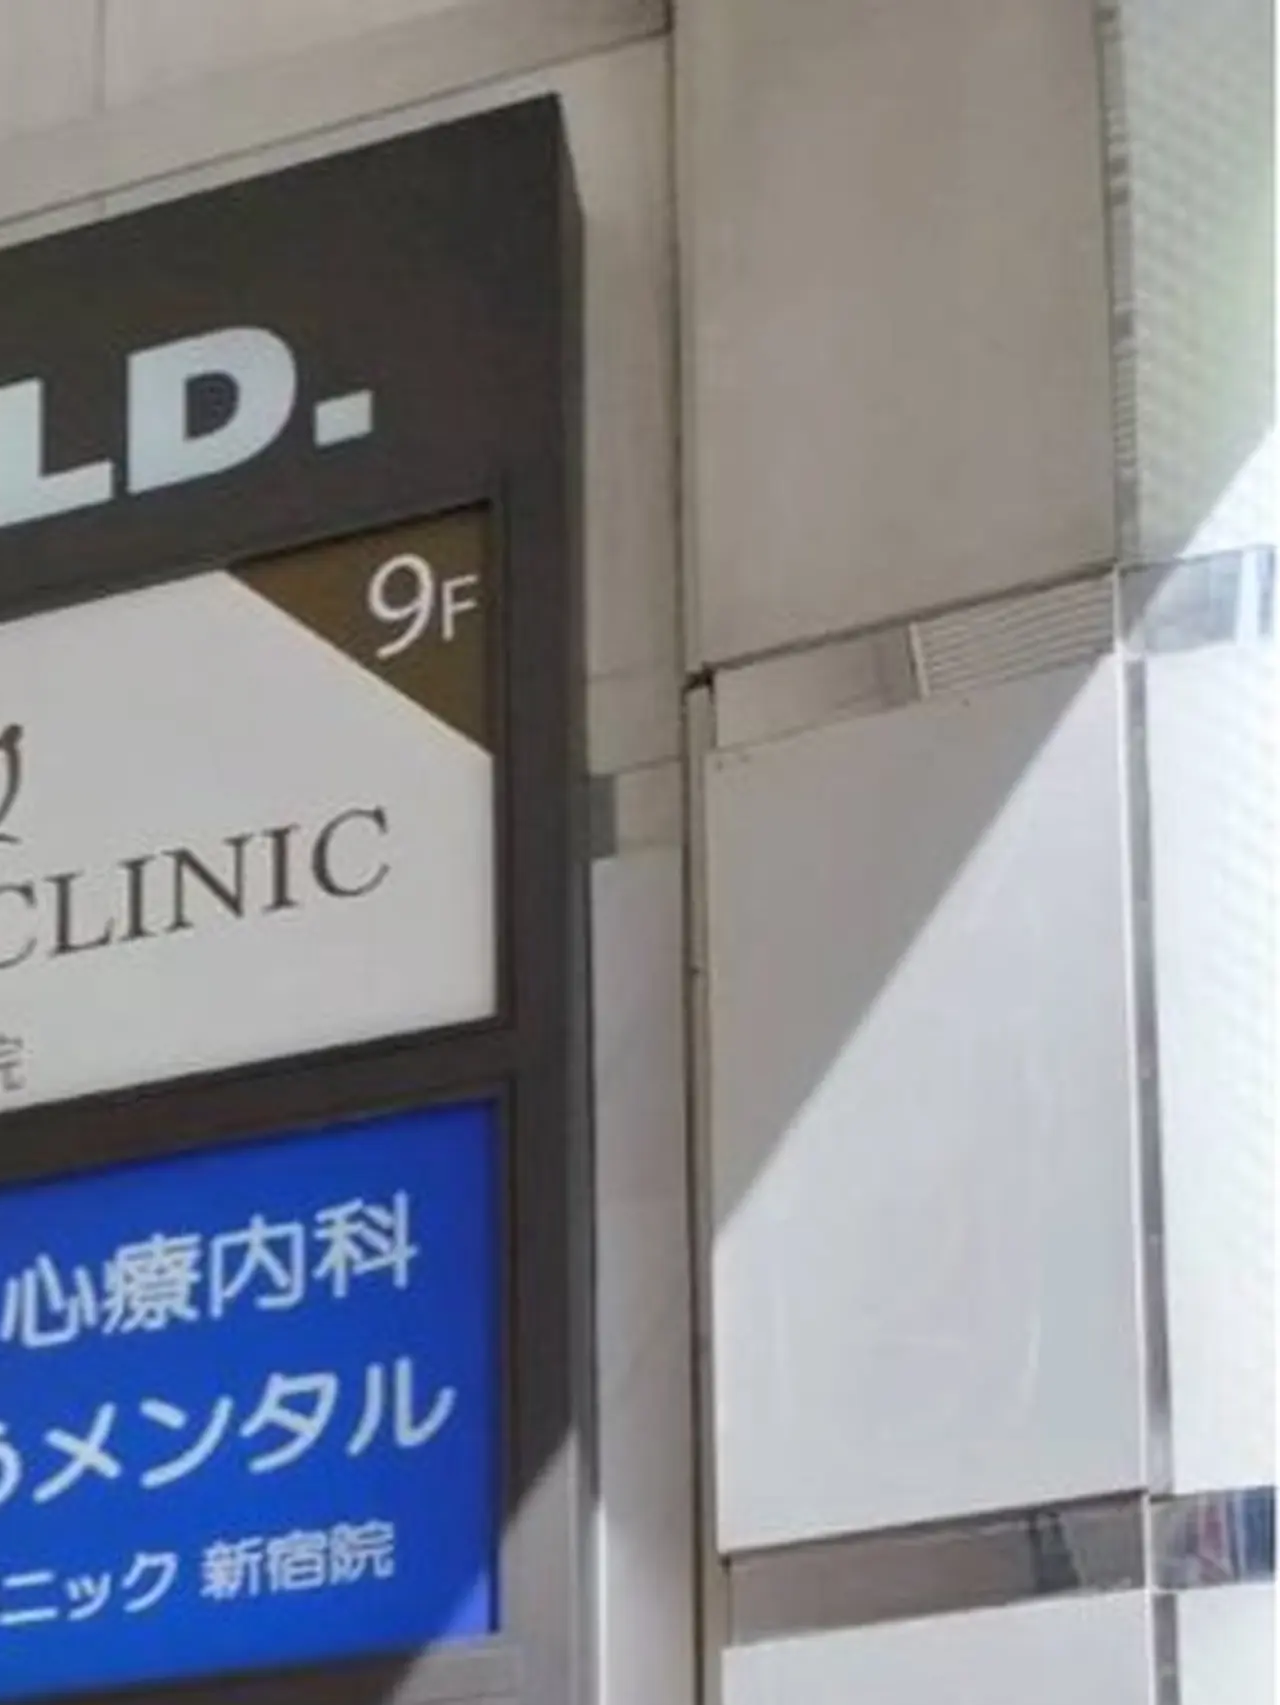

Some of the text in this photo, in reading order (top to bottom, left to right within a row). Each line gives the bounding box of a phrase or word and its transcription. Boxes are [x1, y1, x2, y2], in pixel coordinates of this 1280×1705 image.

[368, 554, 478, 659] 9F
[0, 1191, 418, 1351] 心療内科
[201, 1520, 396, 1600] 新宿院
